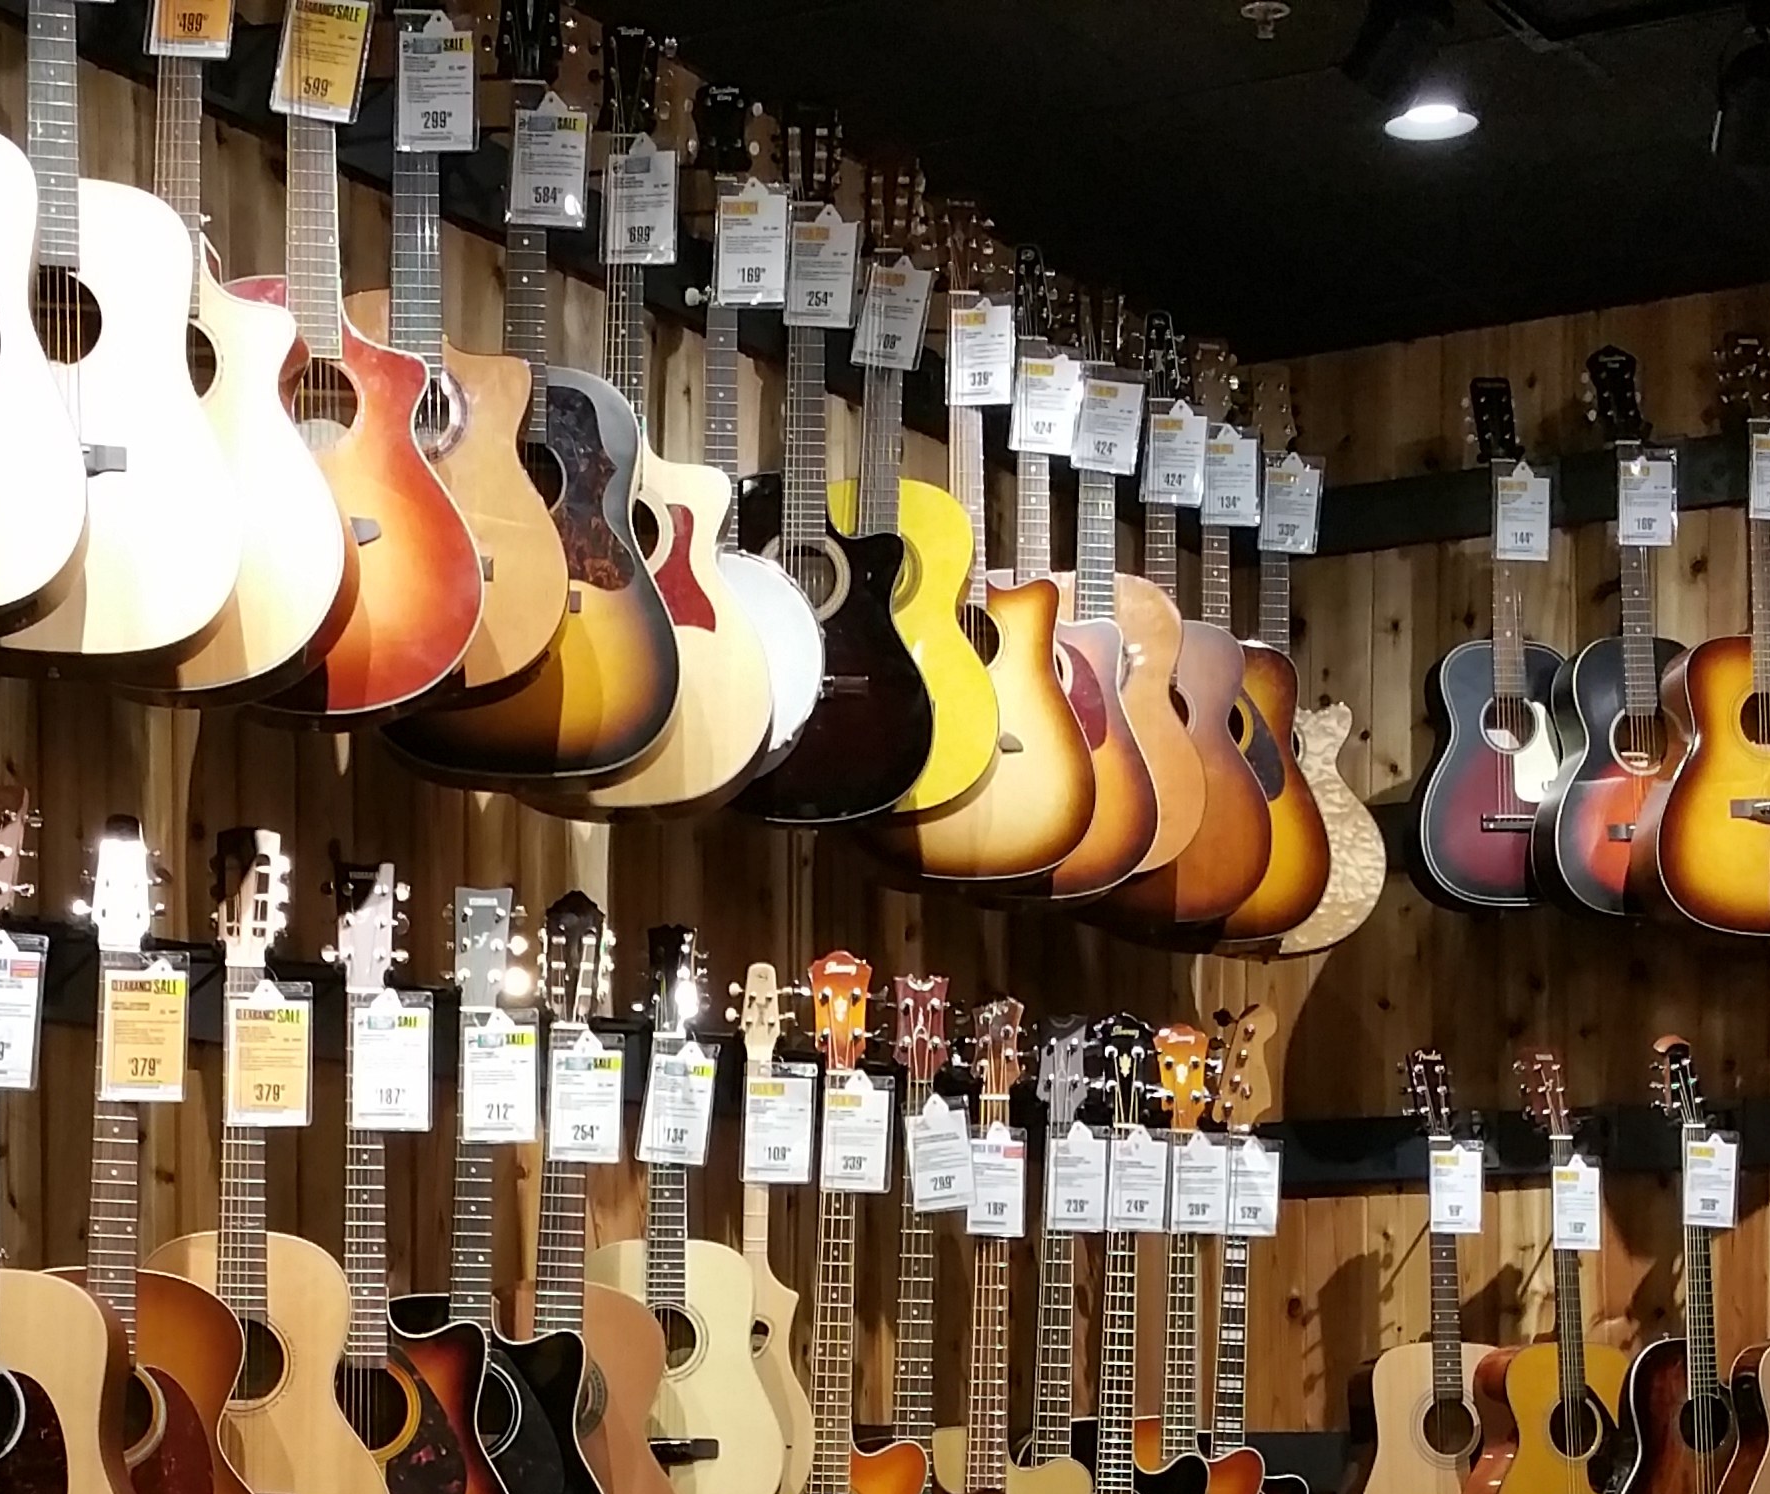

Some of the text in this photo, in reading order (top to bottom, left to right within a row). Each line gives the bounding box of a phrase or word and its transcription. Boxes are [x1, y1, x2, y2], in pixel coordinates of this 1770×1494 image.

[336, 4, 360, 23] SALE
[443, 37, 464, 51] SALE
[557, 117, 577, 131] SALE
[153, 980, 178, 995] SALE
[277, 1009, 300, 1024] SALE
[397, 1016, 418, 1028] SALE
[505, 1033, 525, 1045] SALE
